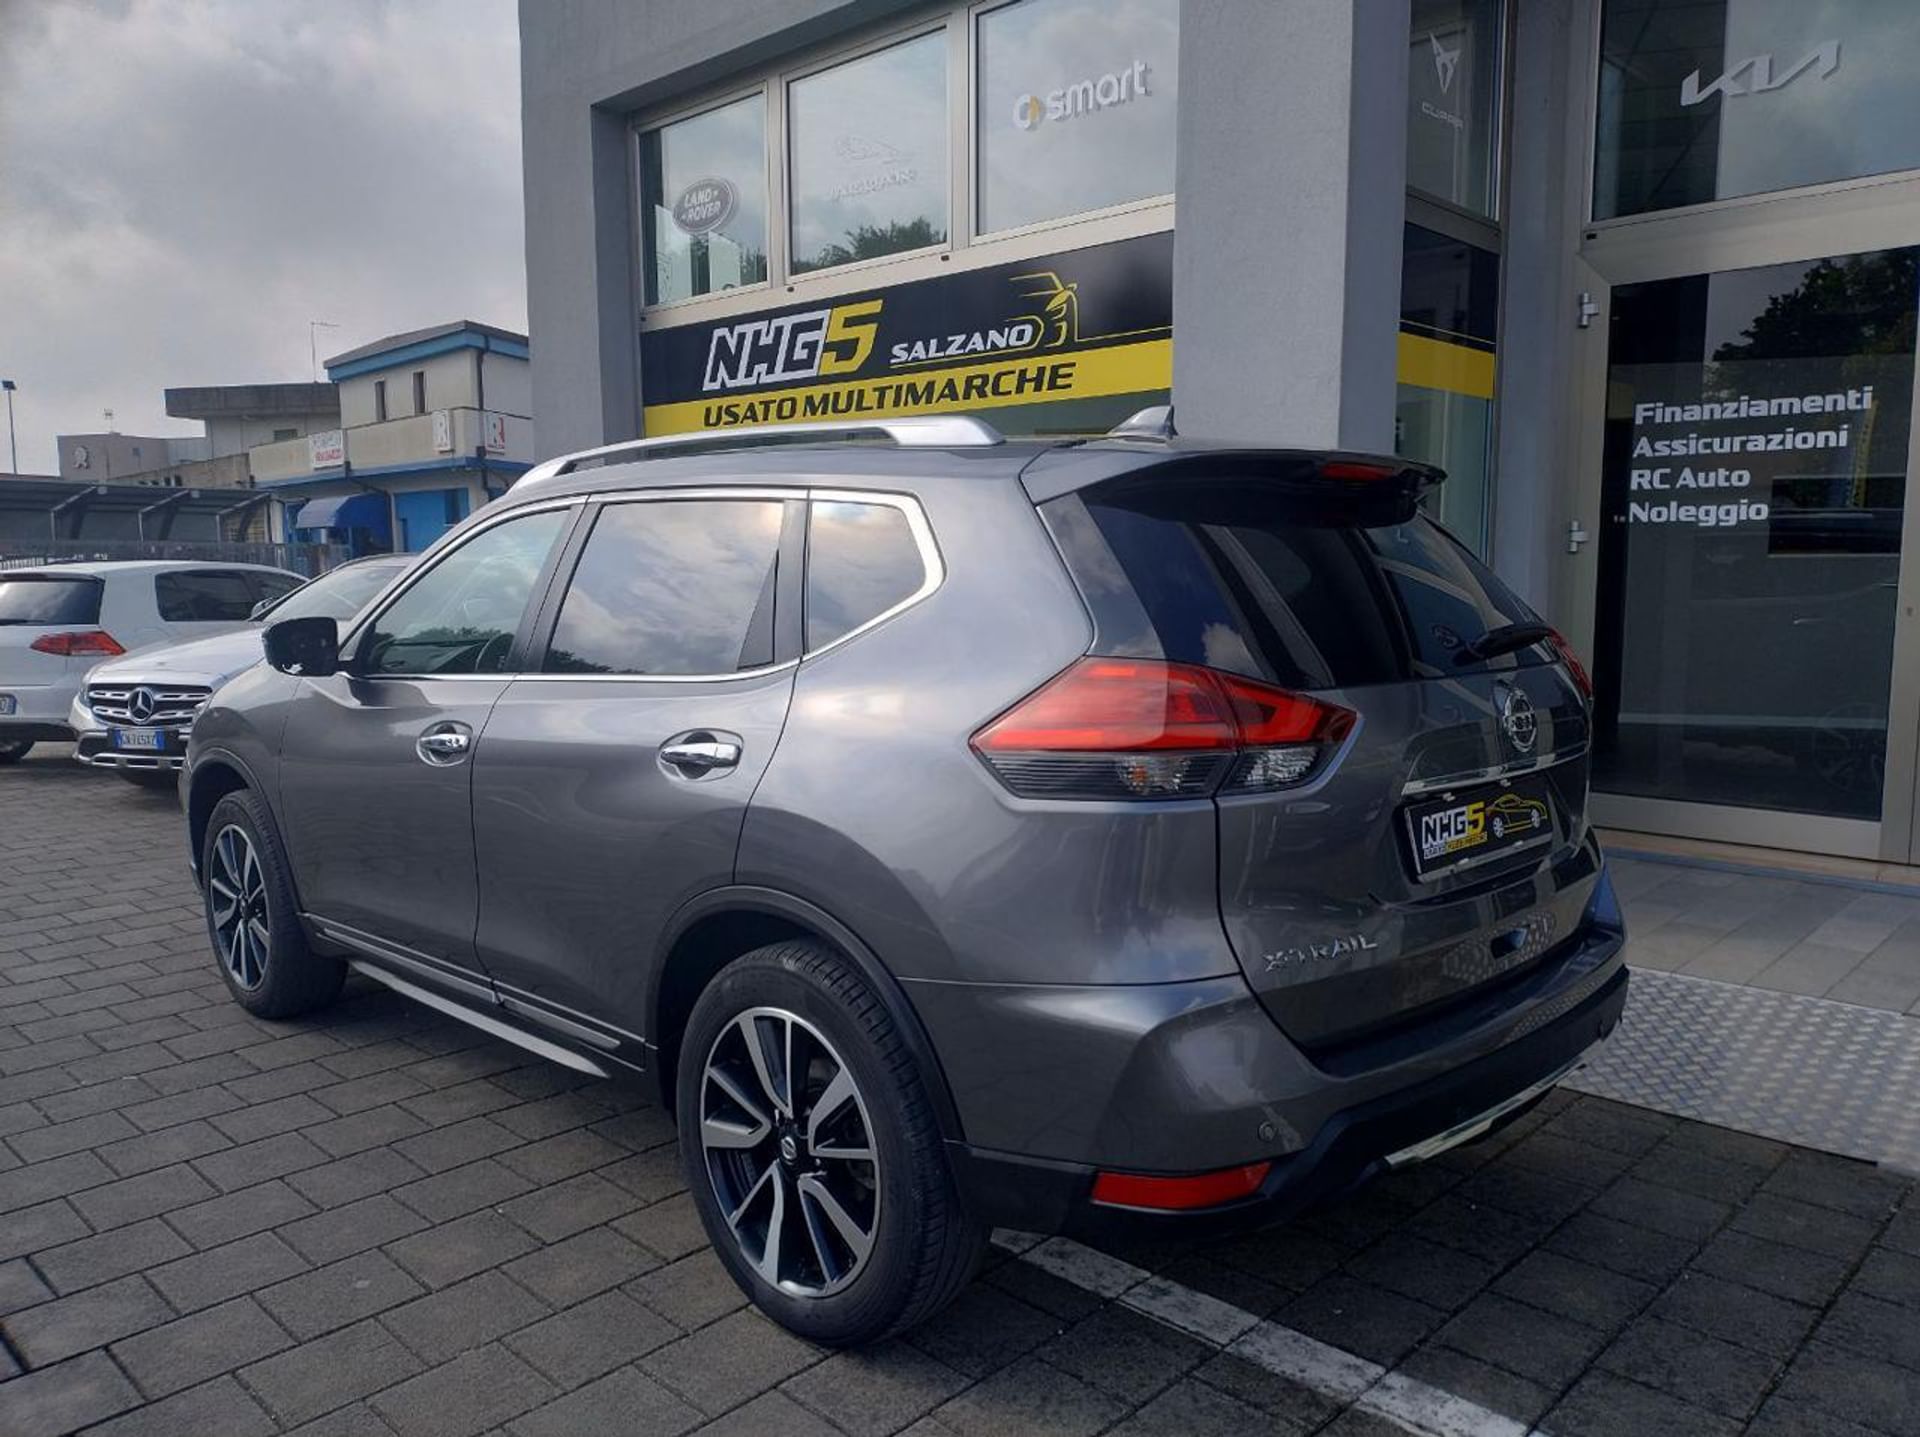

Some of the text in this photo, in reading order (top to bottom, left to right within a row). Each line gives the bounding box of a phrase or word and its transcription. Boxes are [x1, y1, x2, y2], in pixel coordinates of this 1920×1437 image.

[1047, 60, 1147, 120] smart
[684, 188, 713, 208] LAND
[688, 200, 721, 223] ROVER
[702, 299, 883, 391] NHG5
[890, 323, 1034, 364] SALZANO
[703, 361, 1076, 427] USATO MULTIMARCHE
[1634, 385, 1874, 425] Finanziamenti
[1632, 424, 1849, 458] Assicurazioni
[1630, 466, 1751, 490] RC Auto
[1628, 499, 1769, 527] Noleggio
[1421, 801, 1486, 849] NHG5
